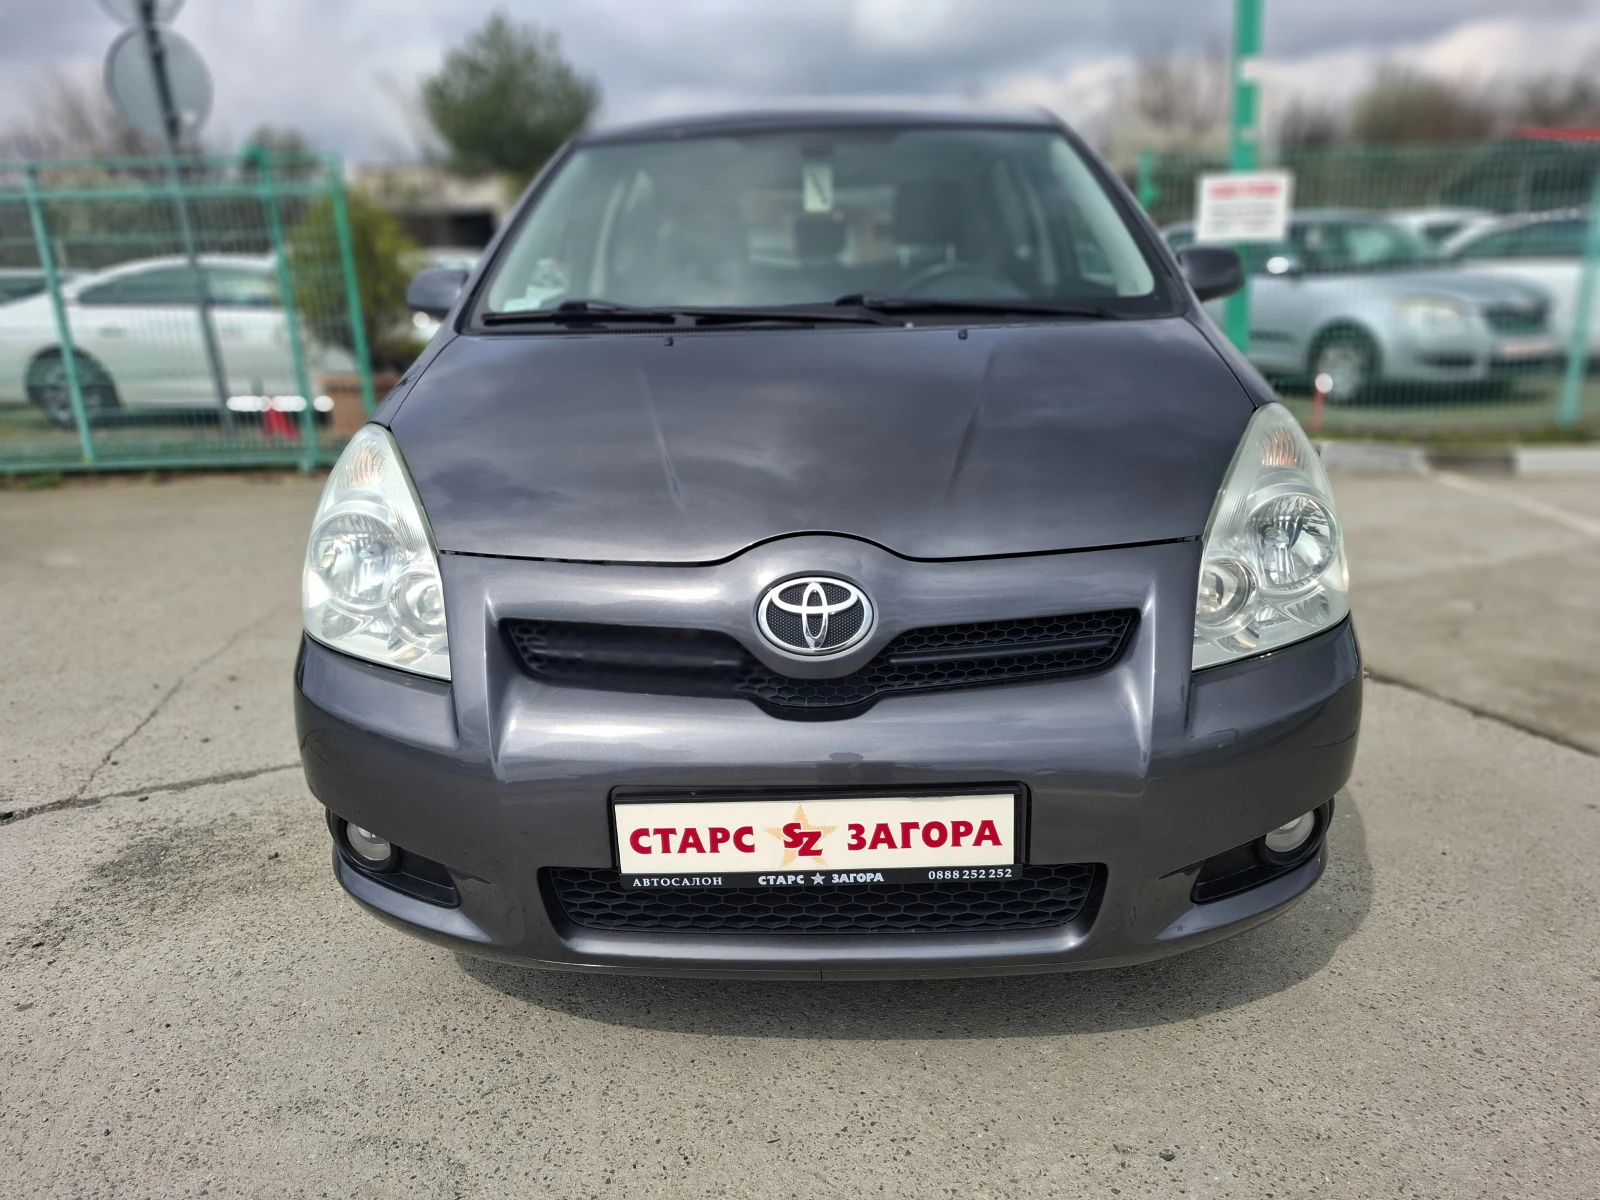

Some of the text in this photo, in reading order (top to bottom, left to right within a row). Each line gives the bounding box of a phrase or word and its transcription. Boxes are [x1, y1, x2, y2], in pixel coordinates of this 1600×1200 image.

[629, 825, 756, 855] СТАРС
[847, 819, 1003, 851] ЗАГОРА
[632, 868, 1013, 887] АВТОСАЛОН СТАРС ЗАГОРА 0888 252 252
